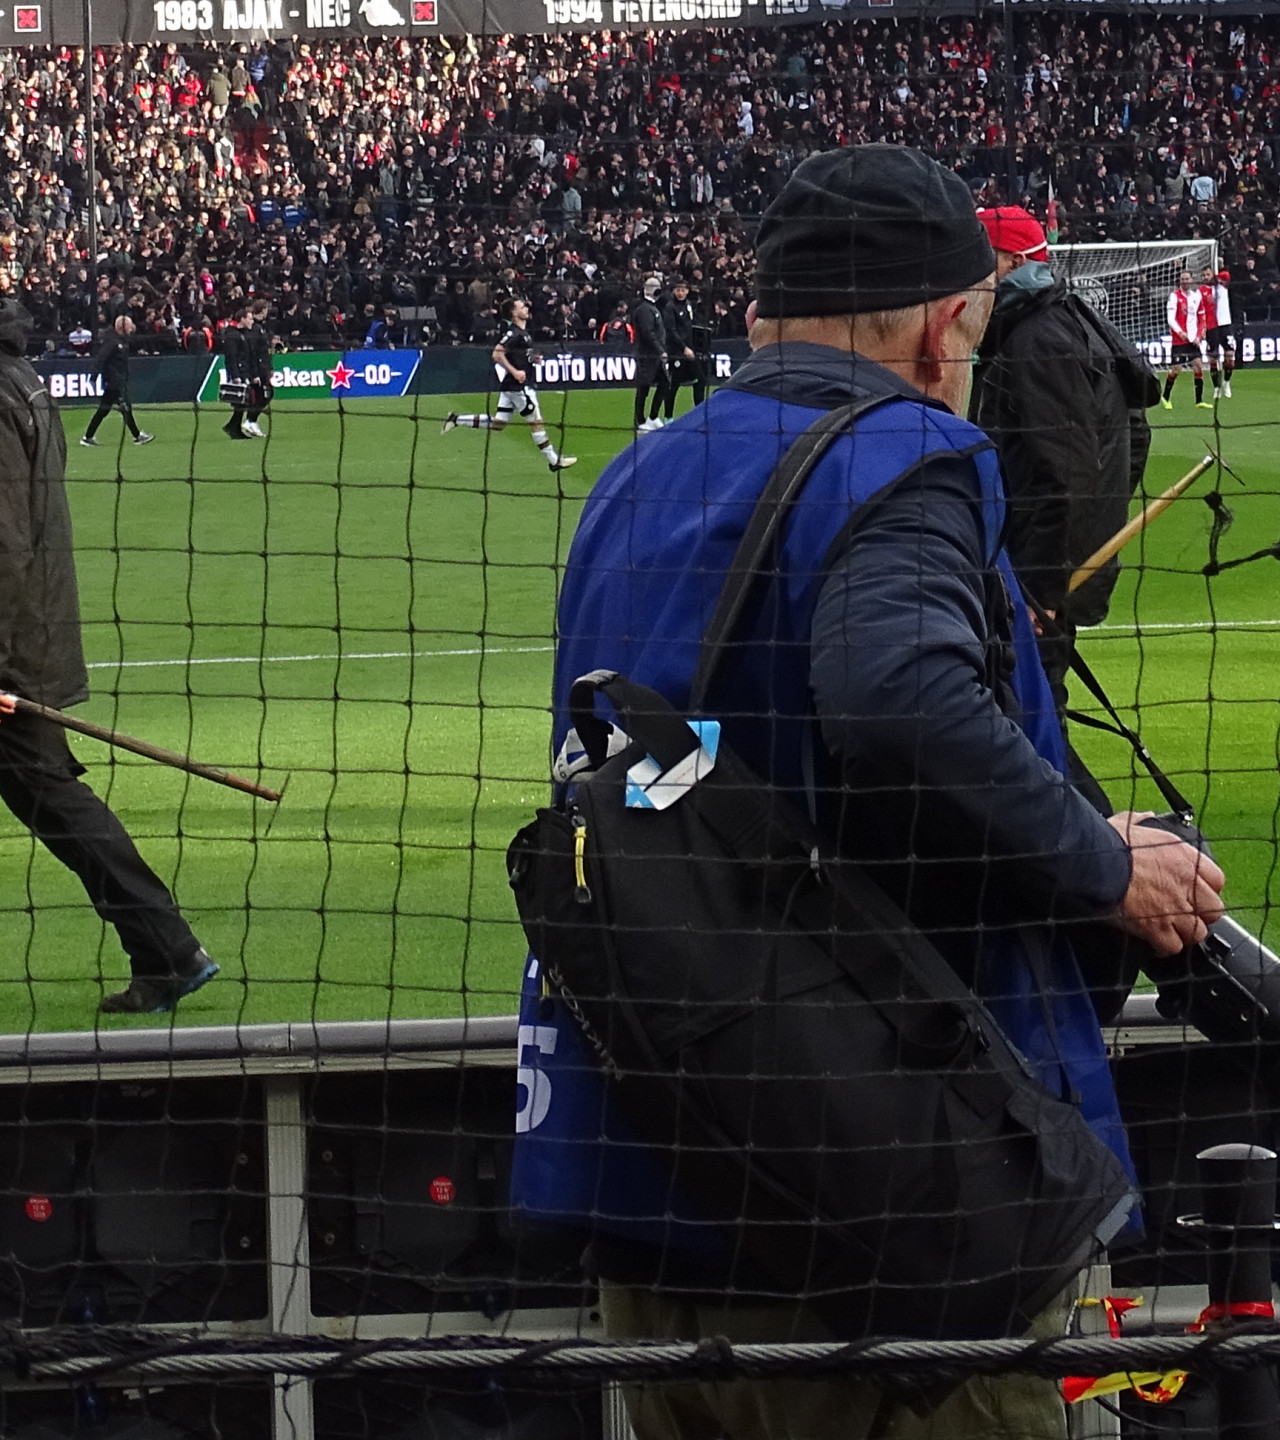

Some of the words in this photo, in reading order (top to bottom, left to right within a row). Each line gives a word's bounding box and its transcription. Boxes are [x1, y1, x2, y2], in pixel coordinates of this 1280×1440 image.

[364, 364, 392, 385] 0.0
[534, 357, 586, 383] TOTO
[590, 357, 637, 382] KNV
